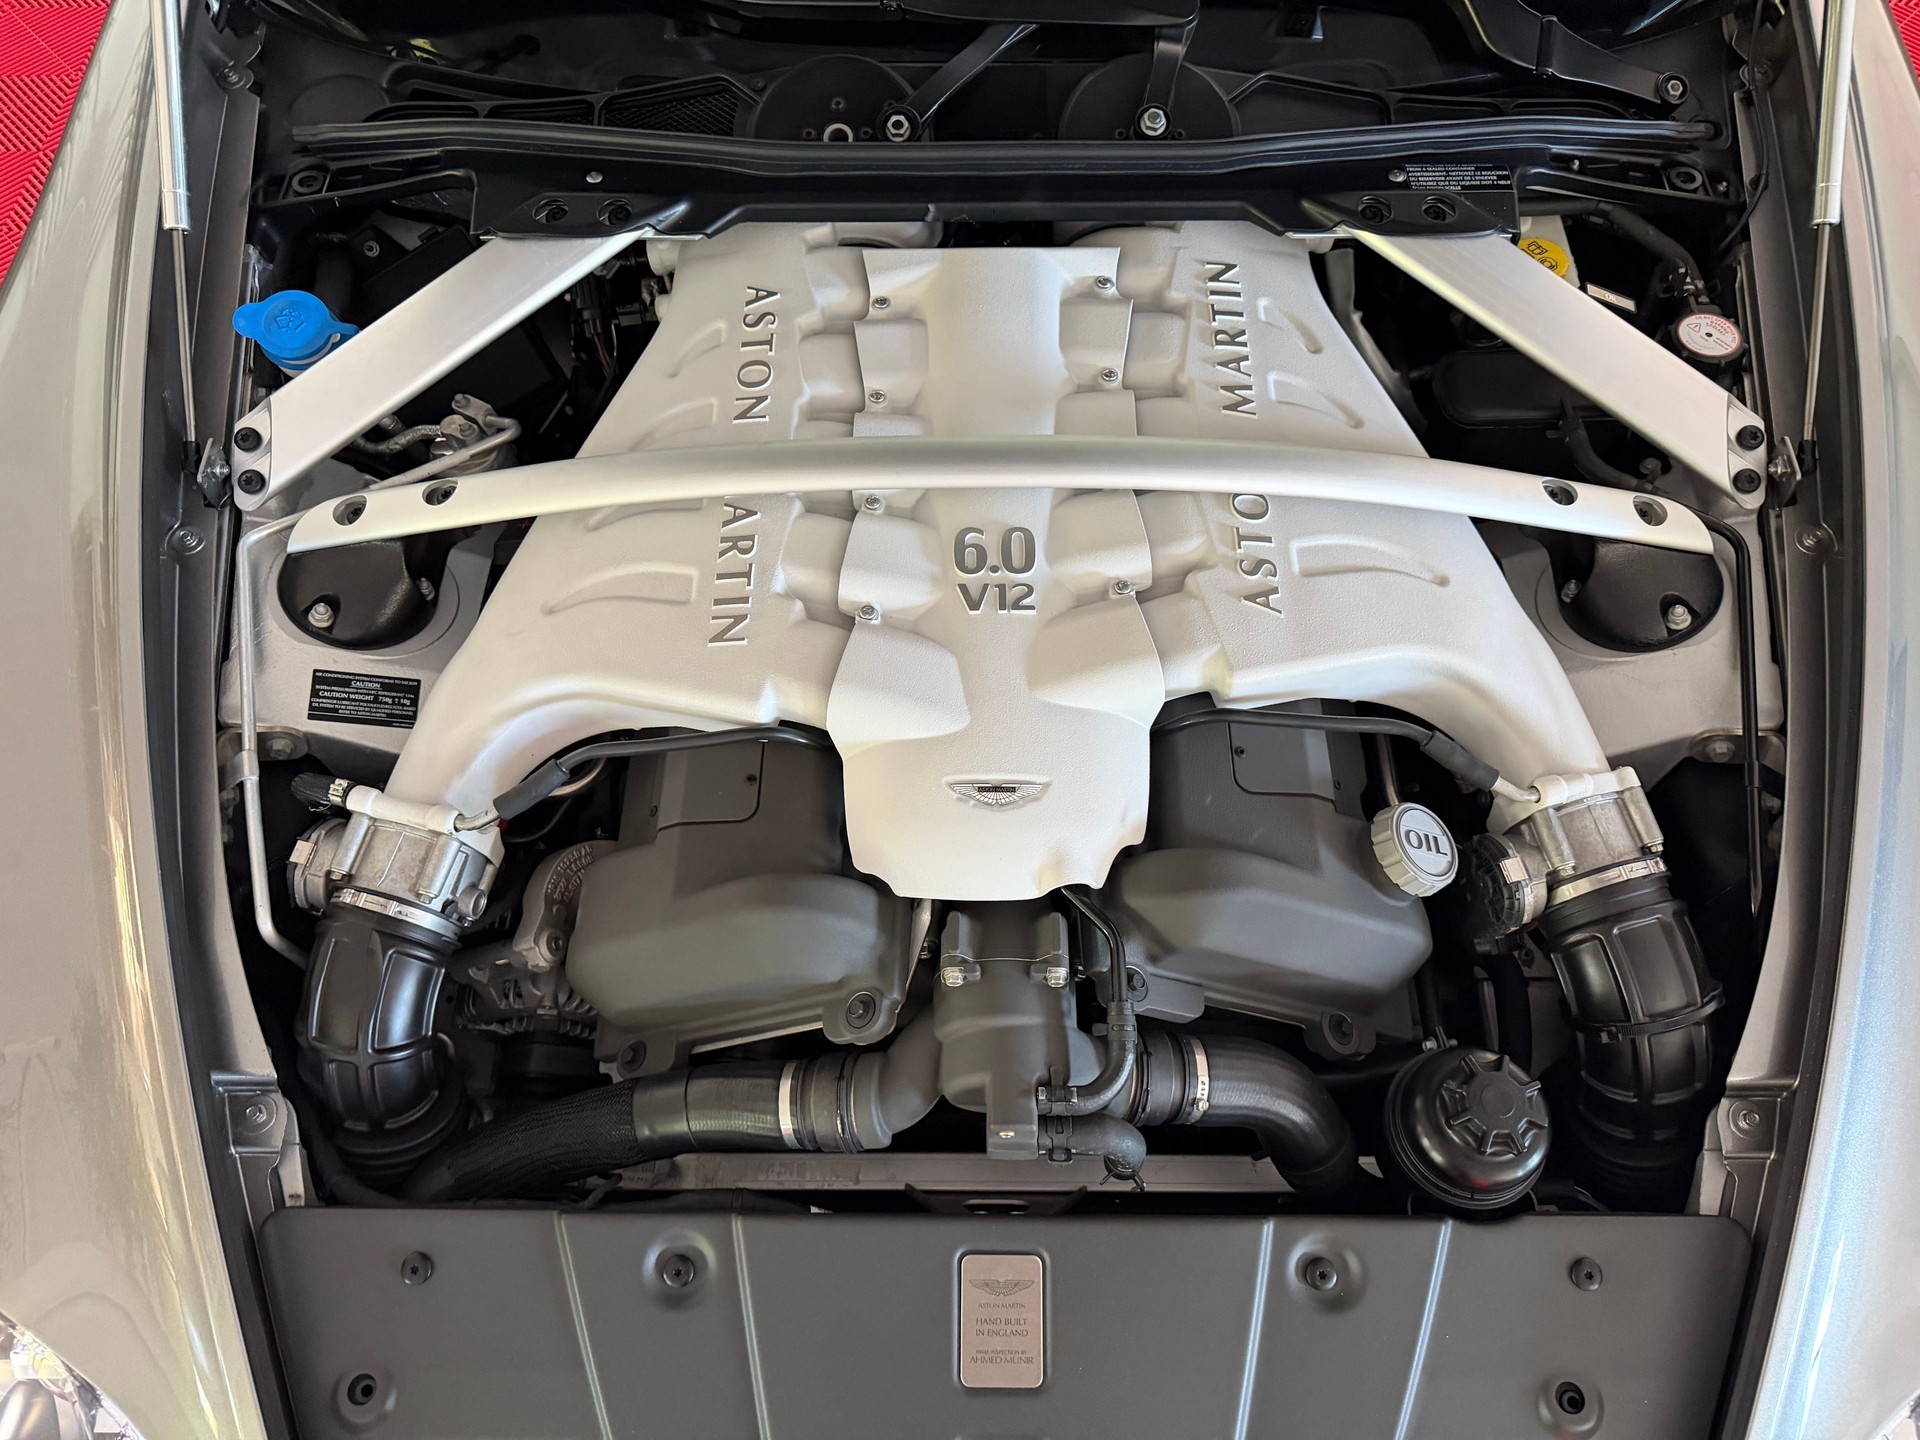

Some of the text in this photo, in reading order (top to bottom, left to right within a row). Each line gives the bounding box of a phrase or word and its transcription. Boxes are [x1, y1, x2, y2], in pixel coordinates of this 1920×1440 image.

[1204, 262, 1284, 618] ASTO MARTIN
[707, 286, 781, 647] ASTON ARTIN
[954, 526, 1036, 577] 6.0
[956, 583, 1036, 614] V12
[1404, 829, 1448, 856] OIL
[976, 1317, 1027, 1326] HAND BUILT
[970, 1356, 1002, 1364] AHMED
